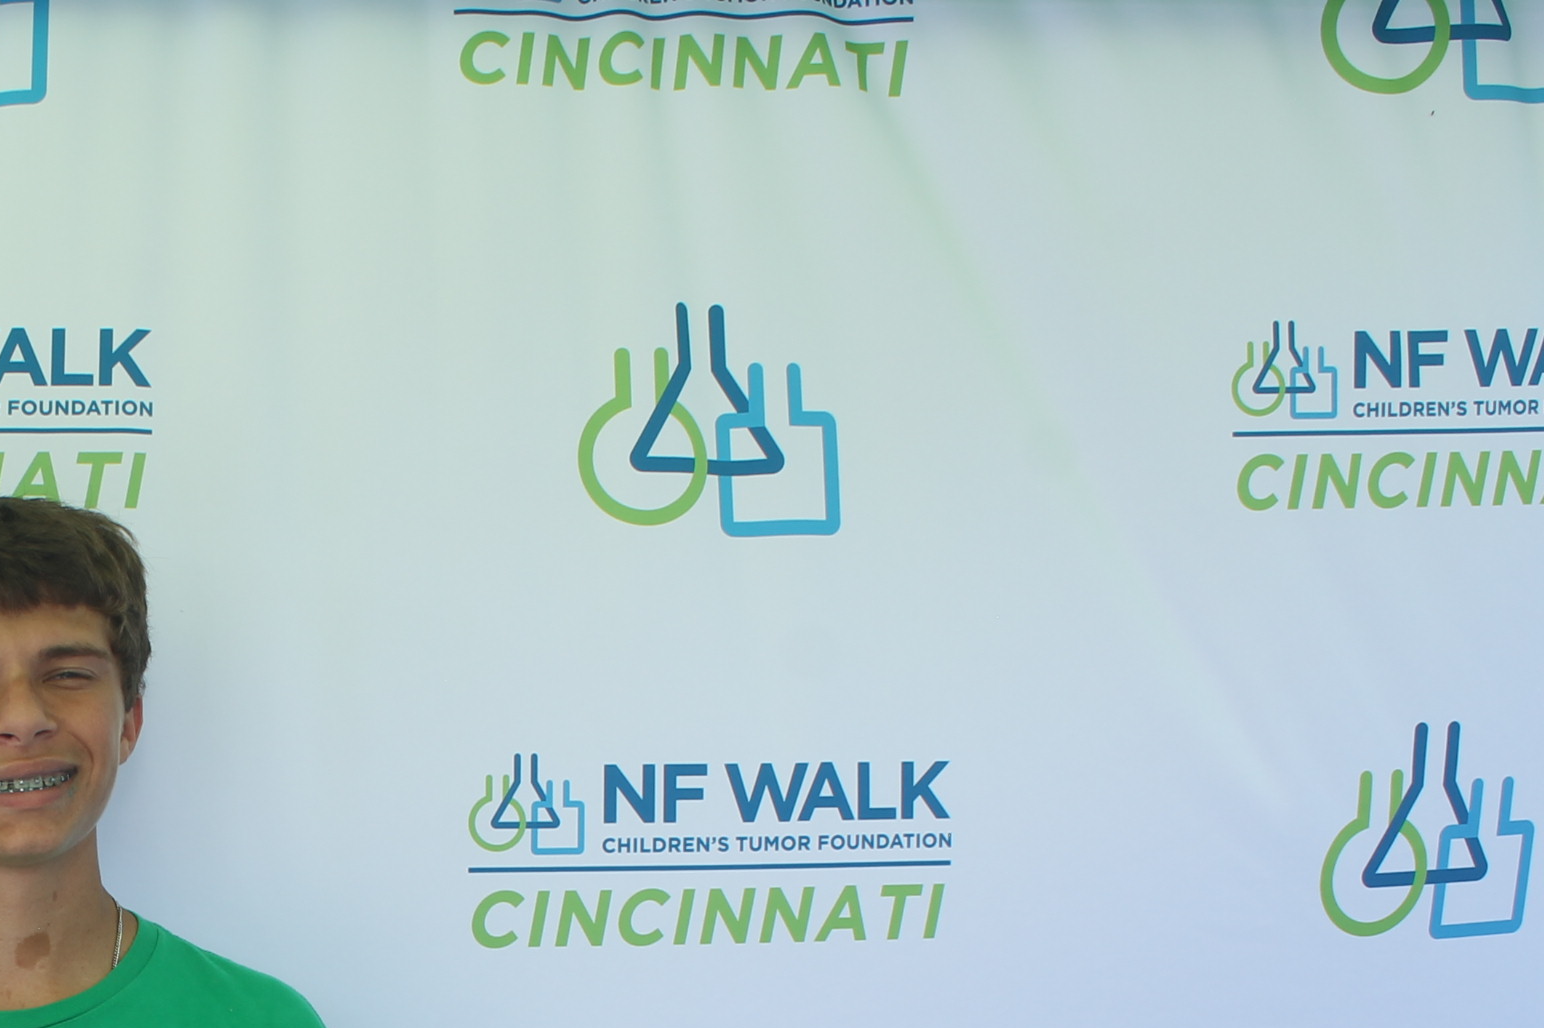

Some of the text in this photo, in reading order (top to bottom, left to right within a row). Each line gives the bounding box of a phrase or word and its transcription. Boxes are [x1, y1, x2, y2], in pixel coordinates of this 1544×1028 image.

[459, 30, 909, 97] CINCINNATI
[1353, 330, 1448, 389] NF
[7, 400, 154, 418] FOUNDATION
[1353, 399, 1539, 419] CHILDREN'S TUMOR
[1236, 449, 1544, 512] CINCINN
[603, 760, 950, 824] NF WALK
[601, 832, 953, 854] CHILDREN'S TUMOR FOUNDATION
[471, 883, 945, 949] CINCINNATI
